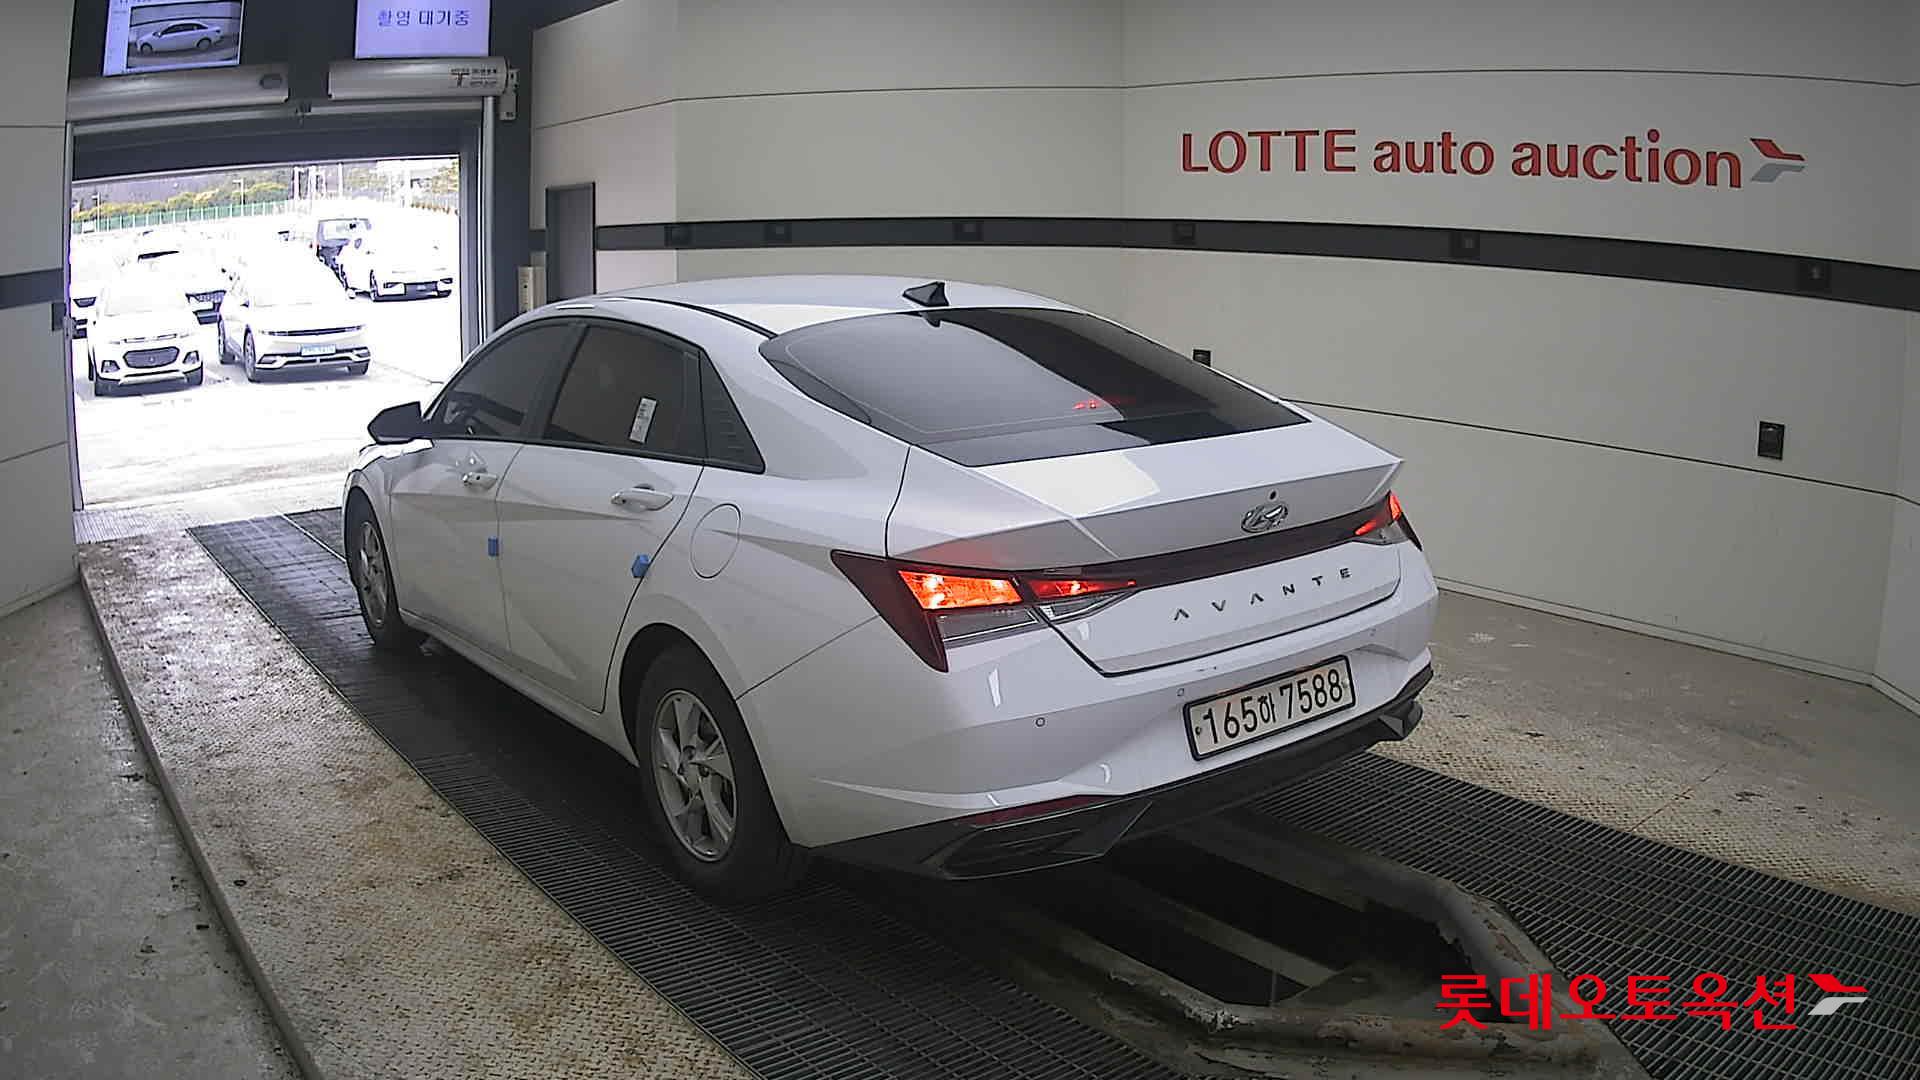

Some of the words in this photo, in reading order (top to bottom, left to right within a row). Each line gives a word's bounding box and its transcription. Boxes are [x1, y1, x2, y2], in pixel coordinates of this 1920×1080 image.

[418, 10, 471, 26] 대기중
[1182, 129, 1357, 174] LOTTE
[1373, 131, 1495, 176] auto
[1511, 129, 1743, 189] auction
[1173, 567, 1352, 621] AVANTE
[1203, 692, 1277, 744] 165하
[1279, 668, 1343, 719] 7588
